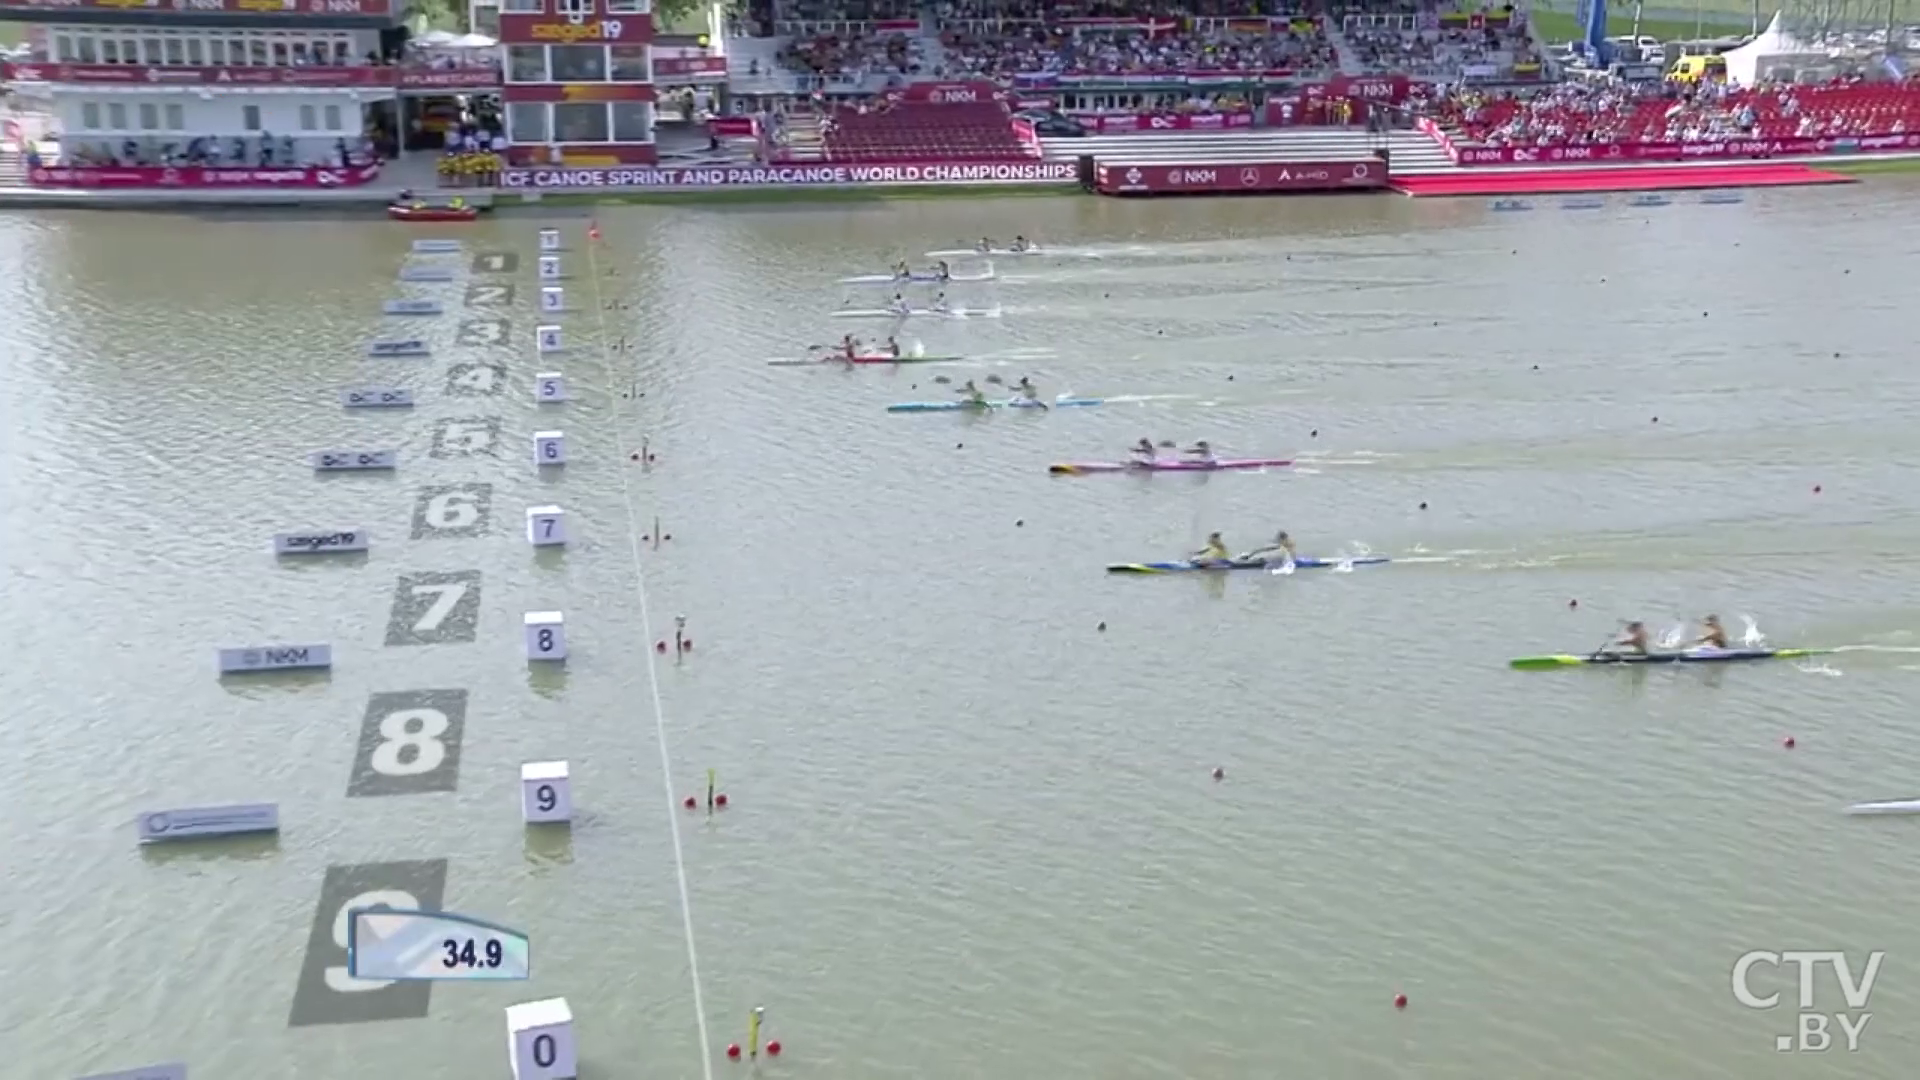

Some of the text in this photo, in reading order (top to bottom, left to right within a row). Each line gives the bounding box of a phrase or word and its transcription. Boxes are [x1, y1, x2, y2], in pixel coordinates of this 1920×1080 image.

[1363, 83, 1393, 97] NKM
[501, 163, 1077, 187] ICF CANOE SPRINT AND PARACANOE WORLD CHAMPIONSHIPS
[1184, 169, 1216, 183] NKM
[543, 261, 555, 274] 2
[543, 381, 556, 396] 5
[545, 442, 558, 459] 6
[542, 518, 556, 538] 7
[537, 628, 554, 652] 8
[265, 649, 309, 664] NKM
[536, 784, 557, 813] 9
[533, 1034, 556, 1068] 0
